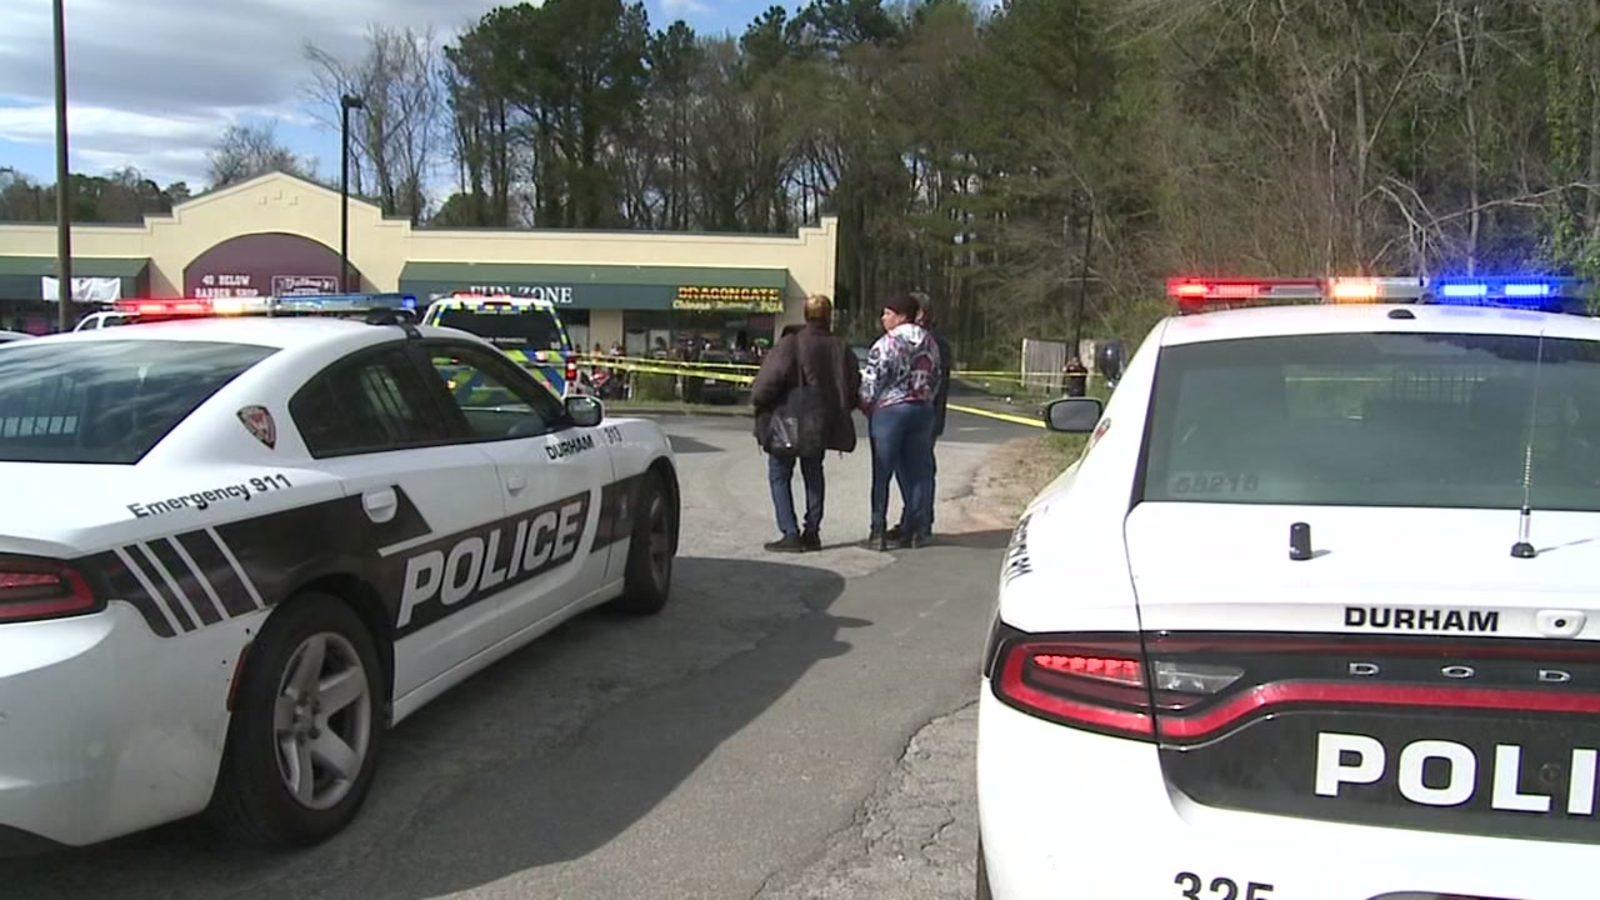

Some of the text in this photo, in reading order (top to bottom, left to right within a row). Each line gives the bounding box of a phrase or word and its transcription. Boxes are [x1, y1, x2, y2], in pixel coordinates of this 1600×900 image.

[219, 275, 250, 286] BELOW
[518, 286, 573, 303] ZONE
[545, 434, 595, 460] DURHAM
[128, 473, 293, 518] Emergency 911
[396, 500, 583, 629] POLICE
[1344, 606, 1500, 633] DURHAM
[1314, 731, 1598, 815] POLI
